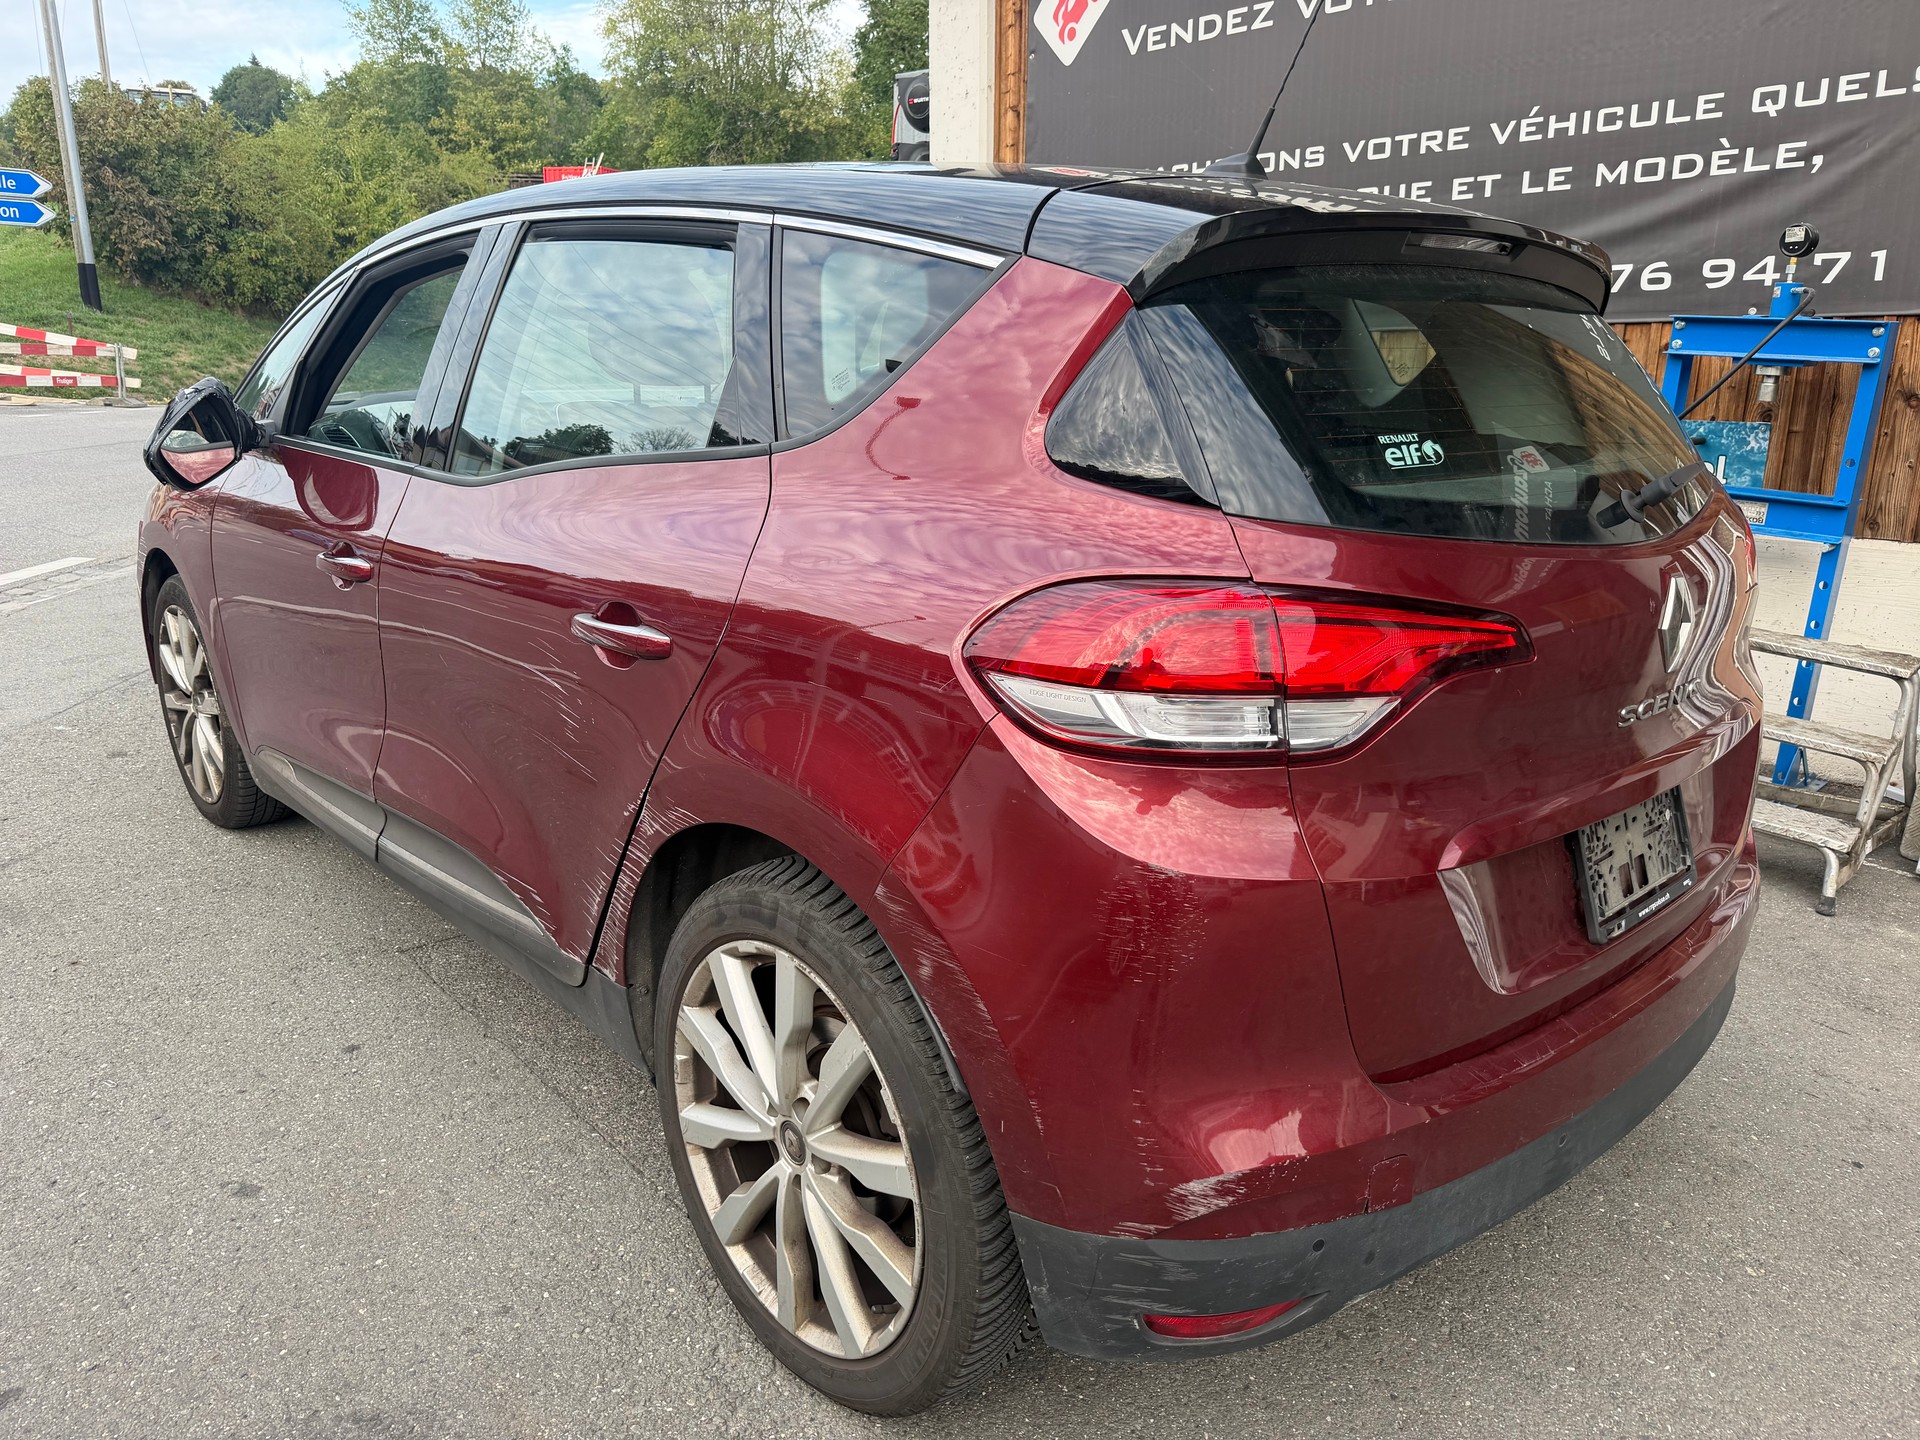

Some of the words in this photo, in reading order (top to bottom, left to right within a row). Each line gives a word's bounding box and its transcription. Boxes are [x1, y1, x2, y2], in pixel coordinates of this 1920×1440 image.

[1121, 1, 1275, 56] VENDEZ
[1342, 126, 1471, 163] VOTRE
[1490, 92, 1725, 145] VÉHICULE
[1751, 66, 1920, 117] QUEL
[1451, 173, 1502, 201] ET
[1521, 166, 1573, 195] LE
[1595, 138, 1825, 188] MODÈLE,
[1701, 255, 1781, 290] 94
[1813, 249, 1888, 284] 71
[1377, 433, 1420, 445] RENAULT
[1384, 443, 1422, 466] elf
[1029, 688, 1045, 697] EDGE
[1045, 691, 1063, 700] LIGHT
[1063, 694, 1087, 703] DESIGN
